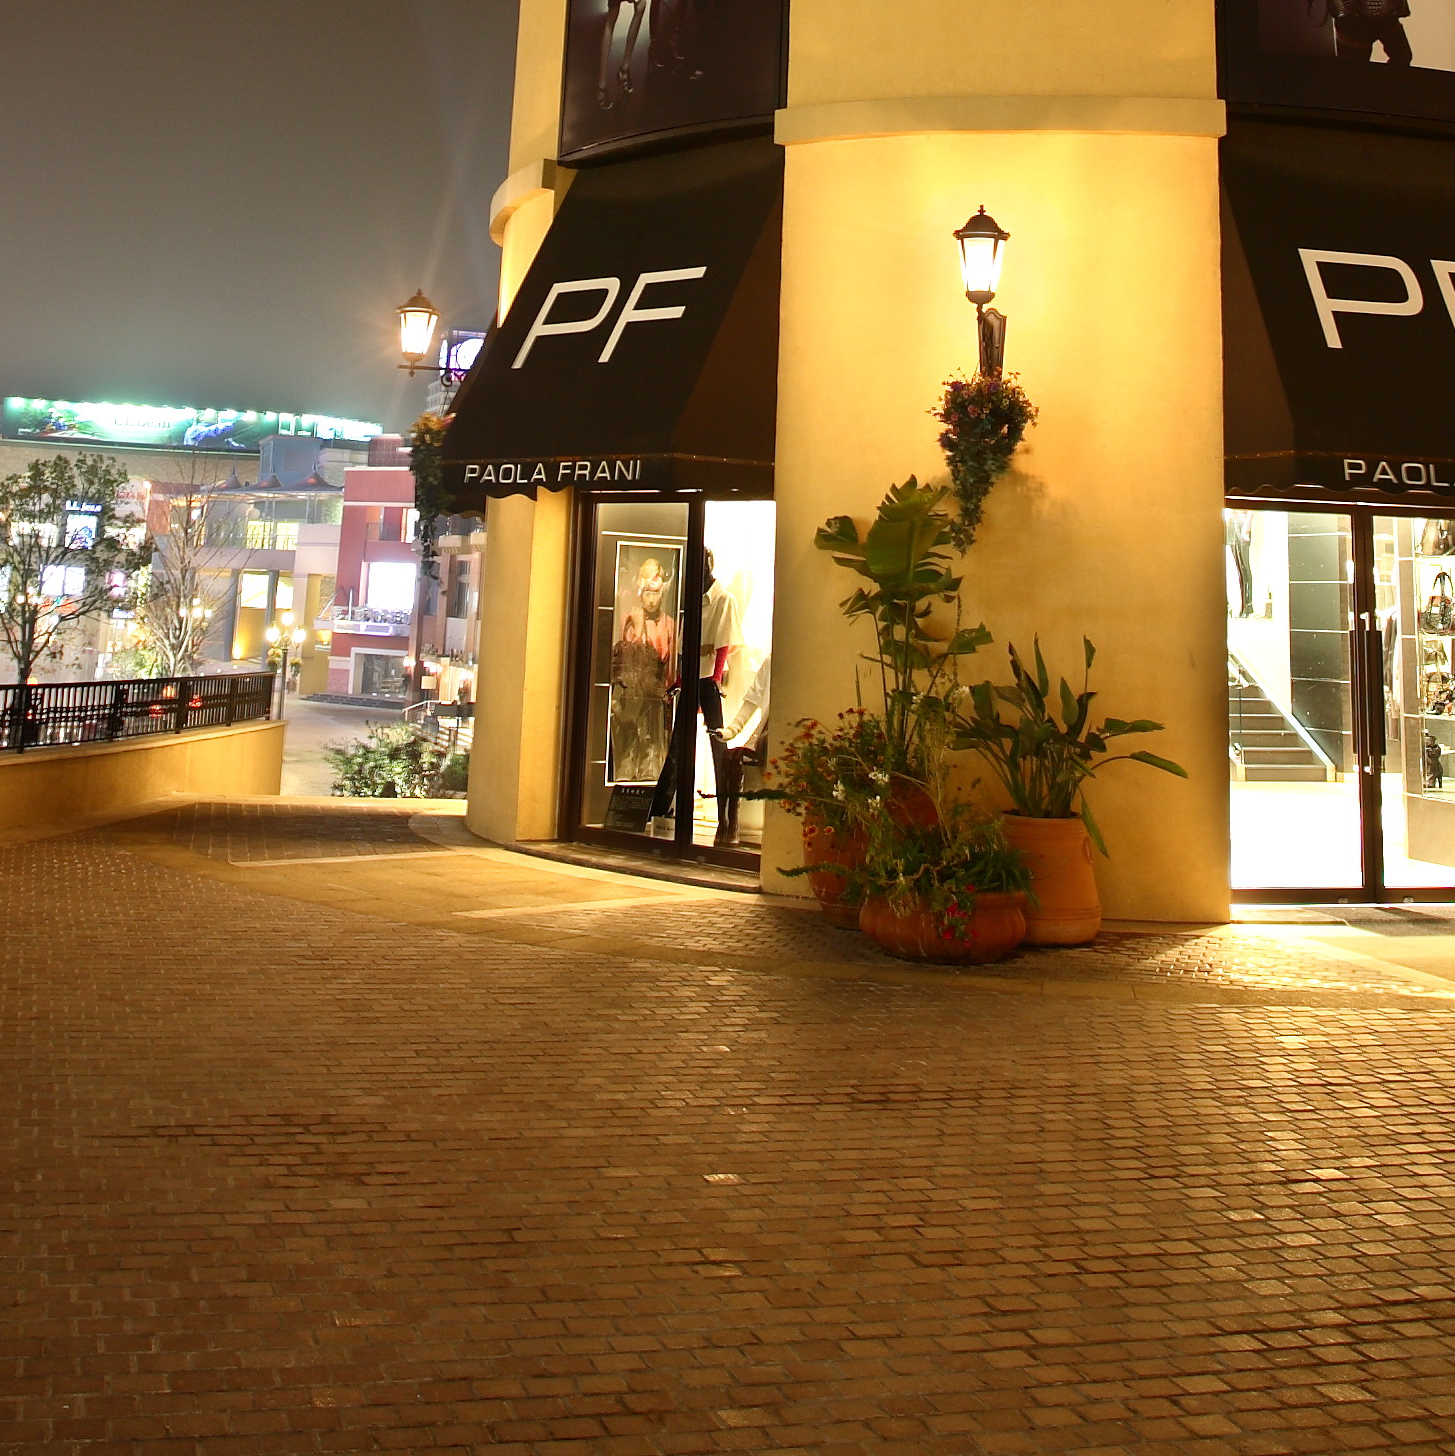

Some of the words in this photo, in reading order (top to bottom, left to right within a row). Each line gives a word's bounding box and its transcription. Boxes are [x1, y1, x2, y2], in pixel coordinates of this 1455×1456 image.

[510, 265, 708, 370] PF
[463, 461, 547, 484] PAOLA
[556, 458, 642, 482] FRANI
